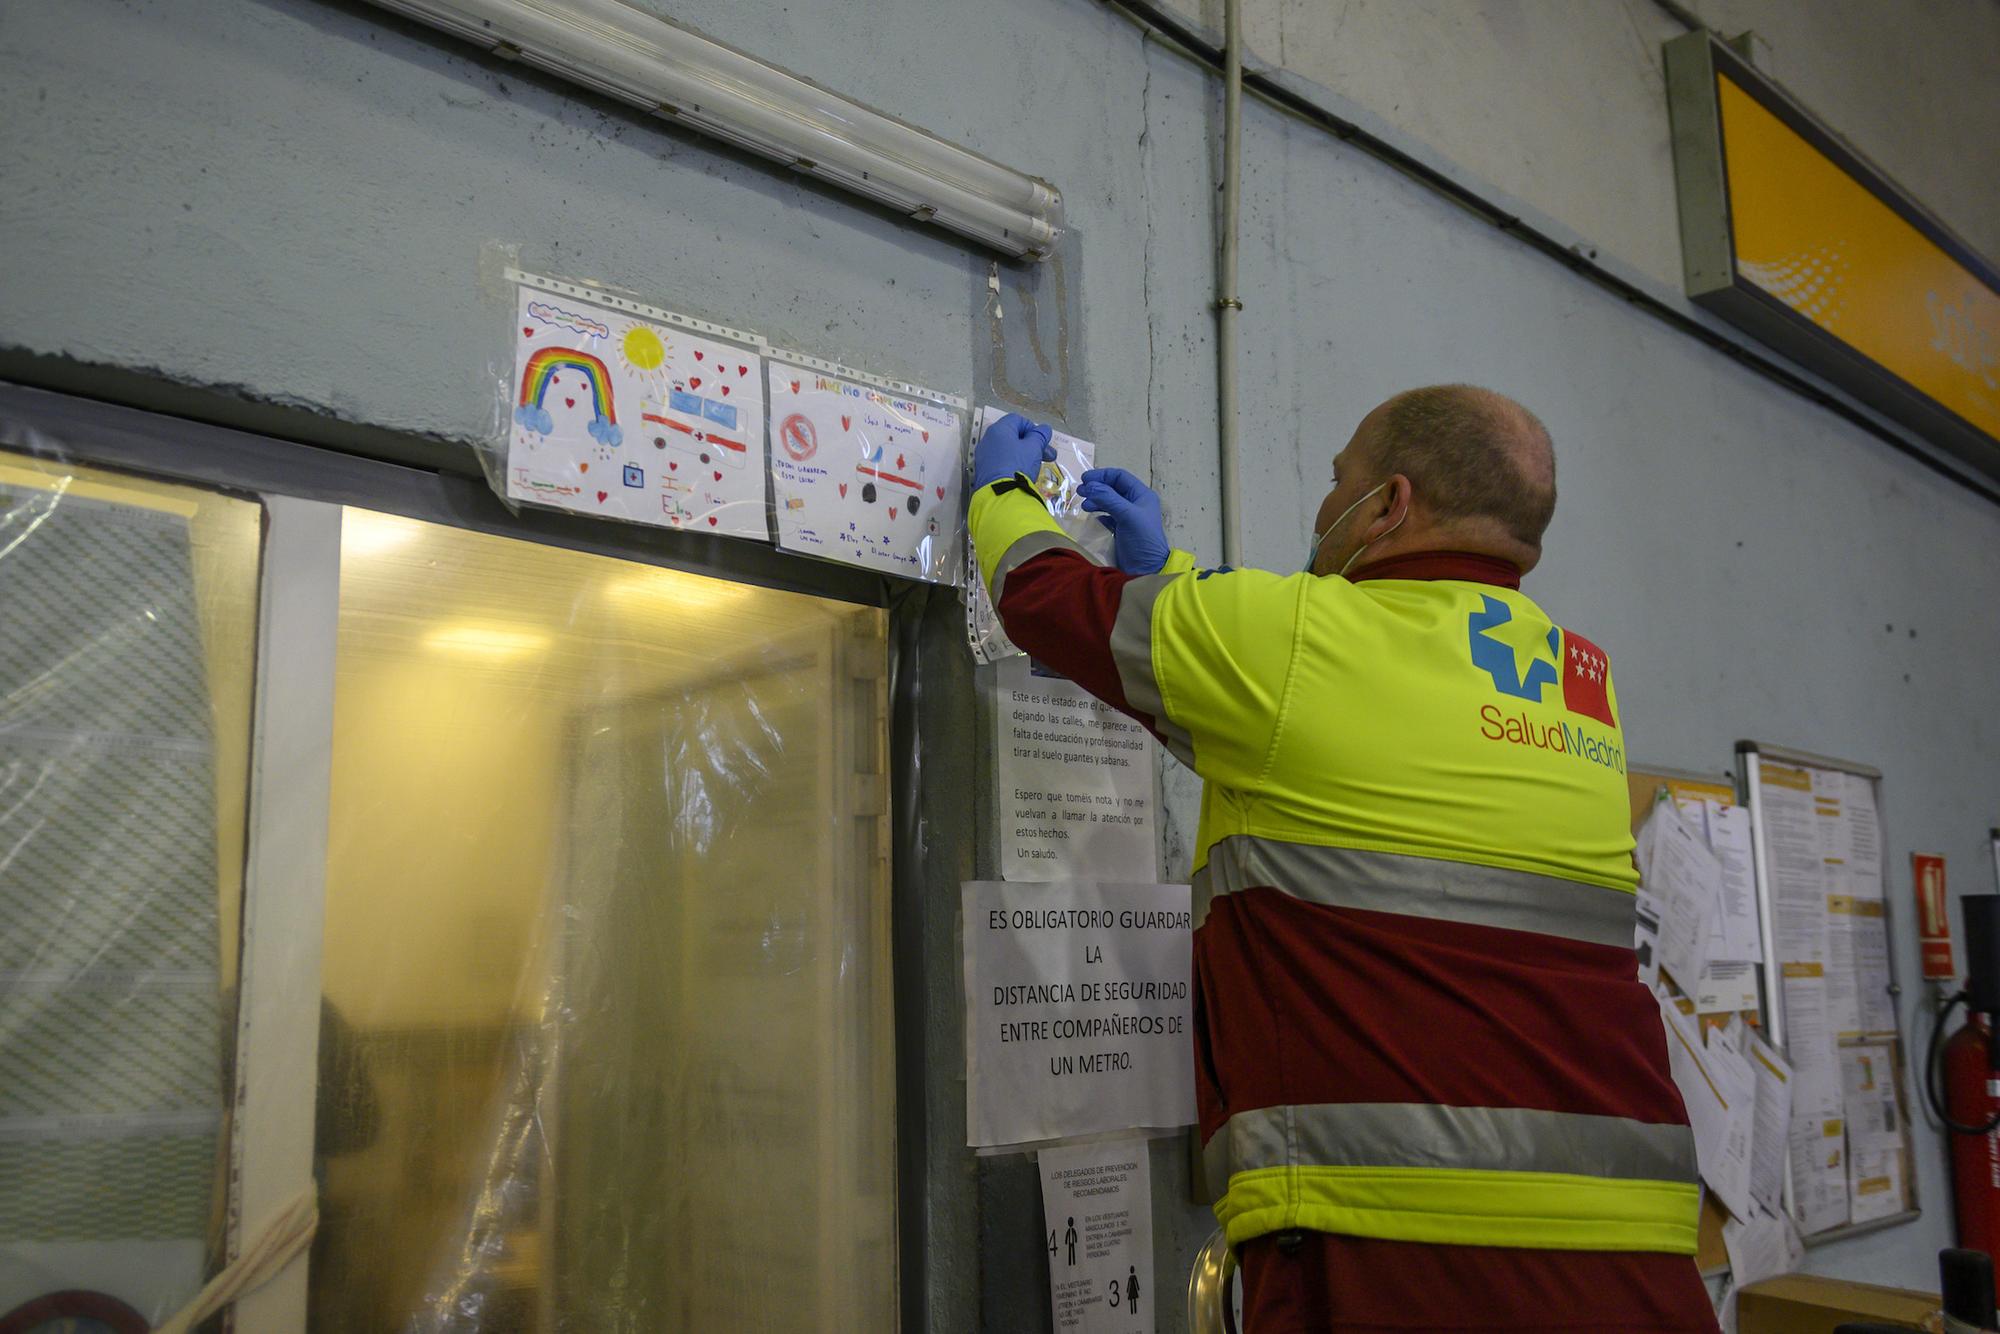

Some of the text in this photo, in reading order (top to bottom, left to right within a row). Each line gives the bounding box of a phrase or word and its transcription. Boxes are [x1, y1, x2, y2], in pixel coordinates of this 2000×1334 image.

[1012, 690, 1029, 703] Este
[1031, 695, 1040, 704] es
[1042, 695, 1050, 705] el
[1051, 696, 1077, 707] estado
[1078, 699, 1088, 709] en
[1090, 699, 1098, 710] el
[1012, 709, 1143, 733] dejando las calles, me parece una
[1013, 727, 1031, 740] falta
[1032, 729, 1043, 740] de
[1044, 730, 1083, 745] educación
[1089, 736, 1143, 751] profesionalidad
[1480, 704, 1624, 776] SaludMadrid
[1013, 746, 1031, 758] tirar
[1033, 747, 1040, 759] al
[1042, 749, 1062, 761] suelo
[1063, 751, 1094, 764] guantes
[1100, 754, 1130, 767] sabanas.
[1014, 789, 1144, 808] Espero que toméis nota y no me
[1014, 809, 1144, 827] vuelvan a llamar la atención por
[1015, 827, 1070, 840] estos hechos.
[1017, 847, 1058, 860] Un saludo.
[989, 909, 1191, 930] ES OBLIGATORIO GUARDAR
[1085, 945, 1103, 964] LA
[993, 981, 1187, 1006] DISTANCIA DE SEGURIDAD
[1000, 1013, 1183, 1043] ENTRE COMPAÑEROS DE
[1050, 1051, 1133, 1076] UN METRO.
[1051, 1169, 1063, 1180] LOS
[1063, 1166, 1096, 1179] DELEGADOS
[1096, 1166, 1104, 1175] DE
[1063, 1180, 1072, 1189] DE
[1096, 1173, 1128, 1185] LABORALES
[1072, 1184, 1120, 1199] RECOMENDAMOS
[1048, 1229, 1058, 1257] 4
[1108, 1279, 1120, 1308] 3
